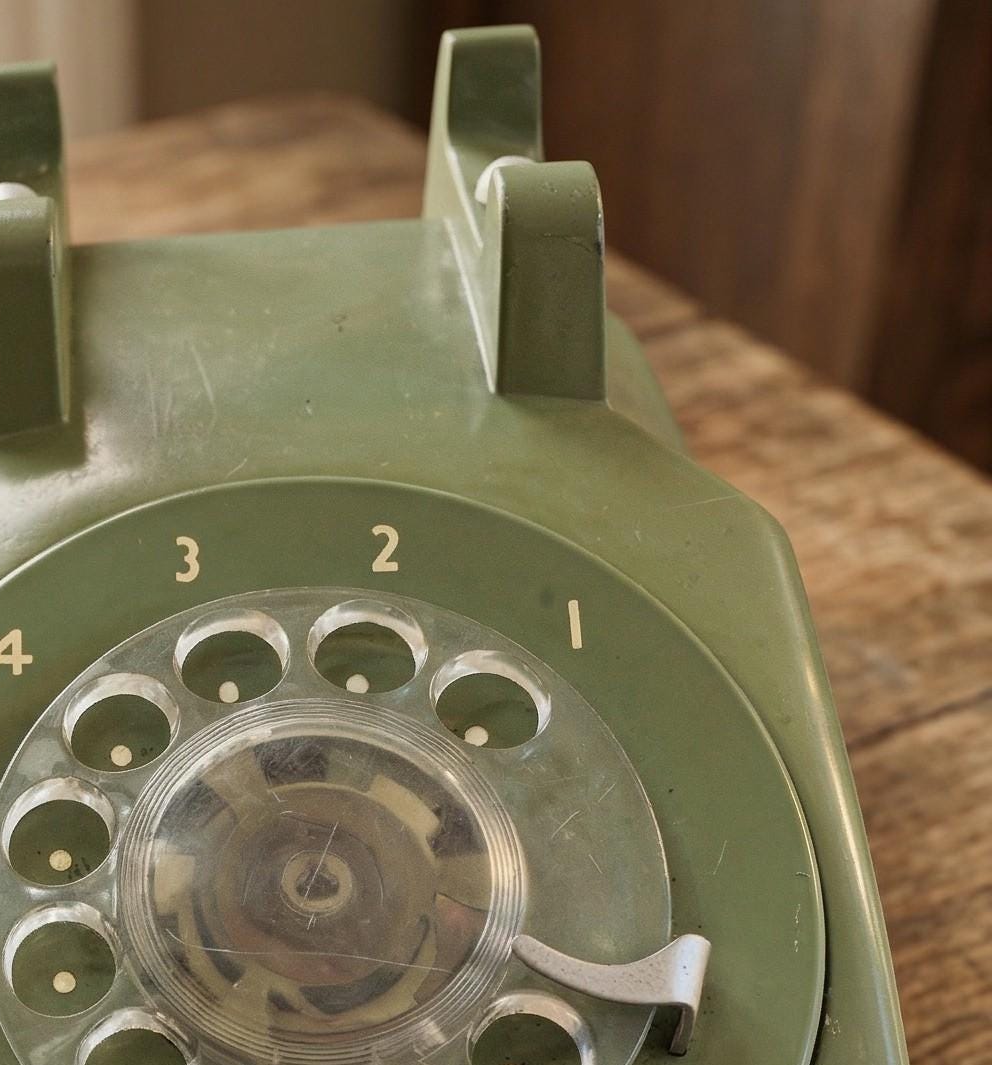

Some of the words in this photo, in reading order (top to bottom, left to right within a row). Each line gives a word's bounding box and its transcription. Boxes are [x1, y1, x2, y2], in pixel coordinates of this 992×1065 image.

[175, 535, 200, 583] 3
[371, 524, 400, 573] 2
[567, 599, 583, 650] 1
